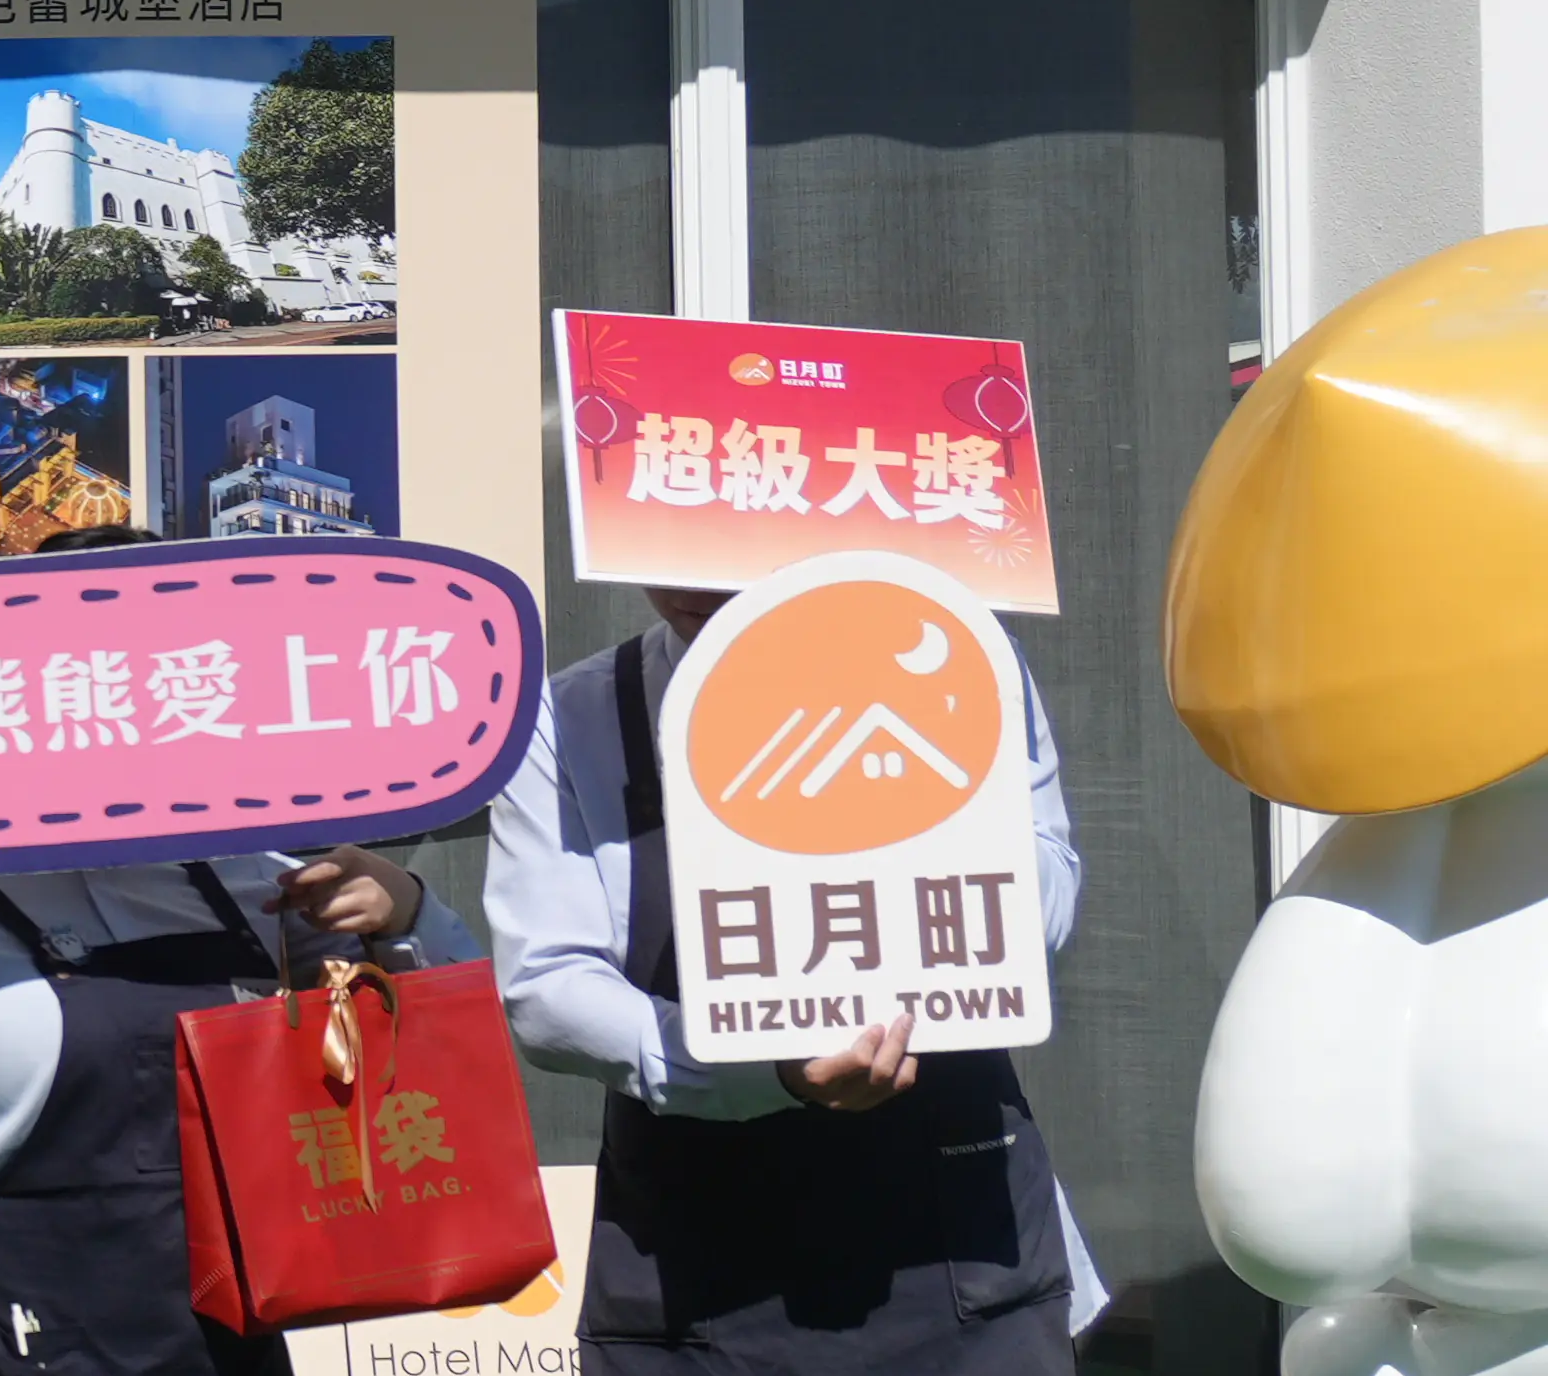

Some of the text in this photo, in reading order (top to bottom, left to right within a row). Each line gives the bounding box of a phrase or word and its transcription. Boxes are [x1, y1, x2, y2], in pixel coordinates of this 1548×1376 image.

[779, 359, 844, 381] 日月町
[626, 411, 1009, 531] 超級大獎
[698, 870, 1017, 982] 日月町
[708, 984, 1027, 1034] HIZUKI TOWN
[288, 1089, 455, 1190] 福袋
